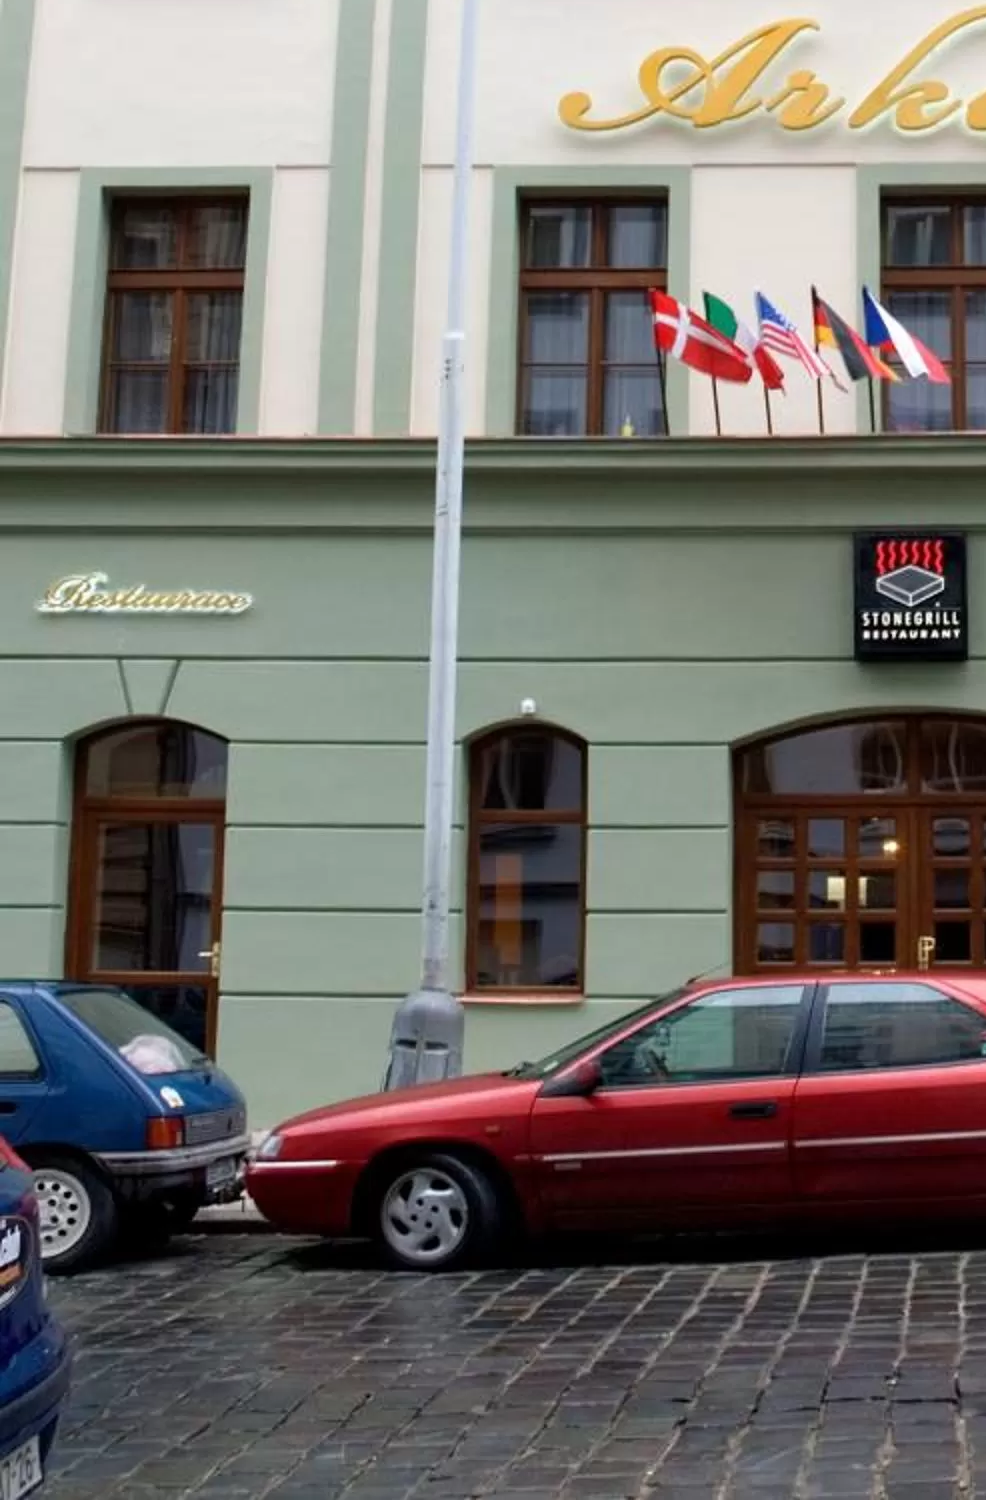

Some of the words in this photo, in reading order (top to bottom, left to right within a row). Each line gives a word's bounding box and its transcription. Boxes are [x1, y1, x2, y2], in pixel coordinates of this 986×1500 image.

[35, 571, 253, 613] Restaurace
[861, 611, 960, 627] STONEGRILL
[862, 628, 961, 640] RESTAURANT
